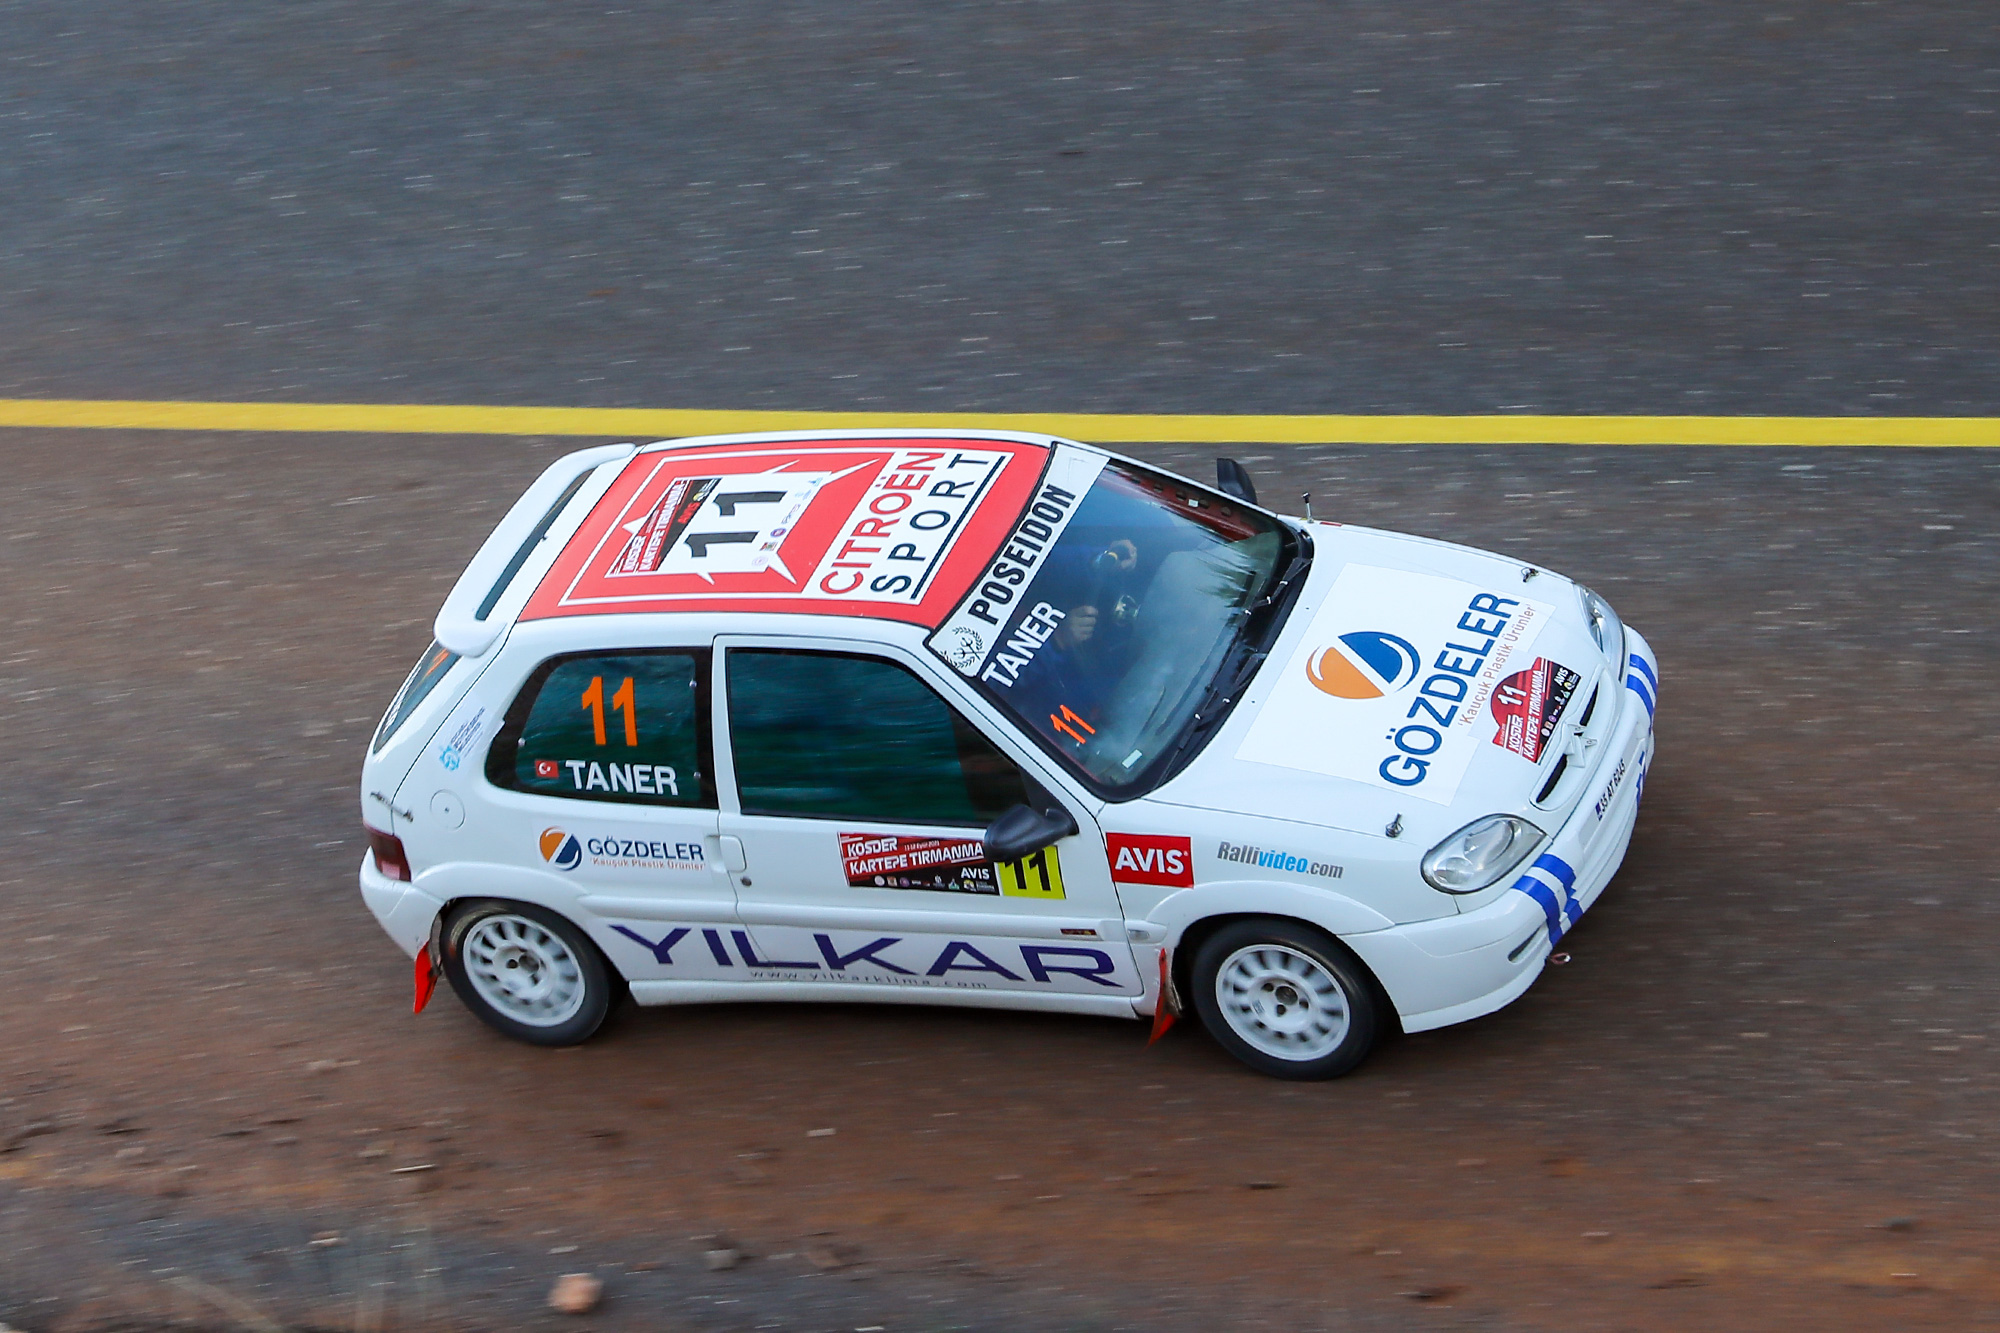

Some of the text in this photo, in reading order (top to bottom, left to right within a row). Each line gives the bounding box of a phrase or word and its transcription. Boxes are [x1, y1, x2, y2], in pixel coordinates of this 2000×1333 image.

[684, 491, 788, 558] 11
[819, 452, 946, 594] CITROËN
[869, 453, 990, 594] SPORT
[967, 483, 1077, 626] POSEIDON
[981, 601, 1066, 688] TANER
[1482, 645, 1514, 680] Plastik
[1379, 593, 1520, 787] GÖZDELER
[1497, 684, 1527, 706] 11
[1553, 667, 1569, 686] AVIS
[582, 676, 638, 747] 11
[1050, 704, 1096, 744] 11
[1523, 669, 1545, 760] KARTEPE TIRMANMA
[1508, 714, 1524, 752] KOSDER
[565, 759, 679, 796] TANER
[587, 835, 705, 861] GÖZDELER
[847, 836, 898, 858] KOSDER
[849, 841, 984, 876] KARTEPE TIRMANMA
[1217, 841, 1343, 879] Rallivideo.com
[961, 867, 990, 880] AVIS
[1005, 849, 1051, 891] 11
[607, 924, 1125, 989] YILKAR
